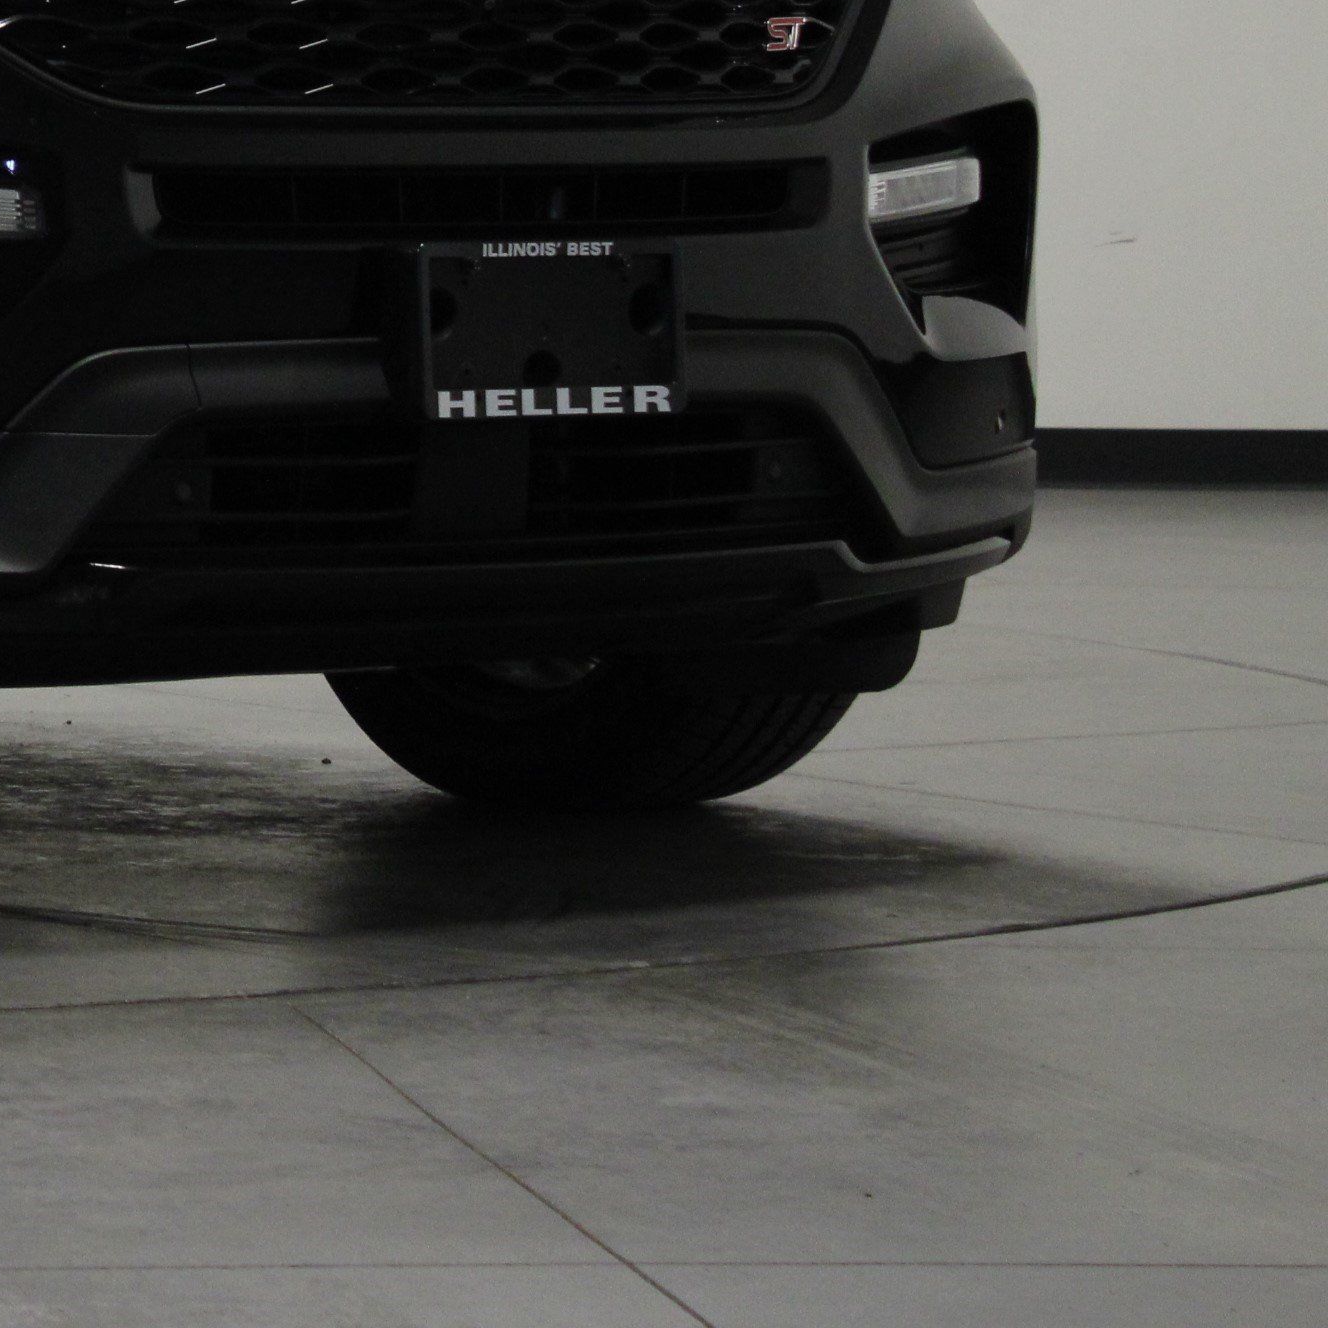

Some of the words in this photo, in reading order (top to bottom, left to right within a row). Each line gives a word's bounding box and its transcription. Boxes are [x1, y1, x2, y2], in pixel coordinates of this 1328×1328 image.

[766, 16, 806, 52] ST
[566, 241, 614, 257] BEST
[437, 384, 672, 419] HELLER
